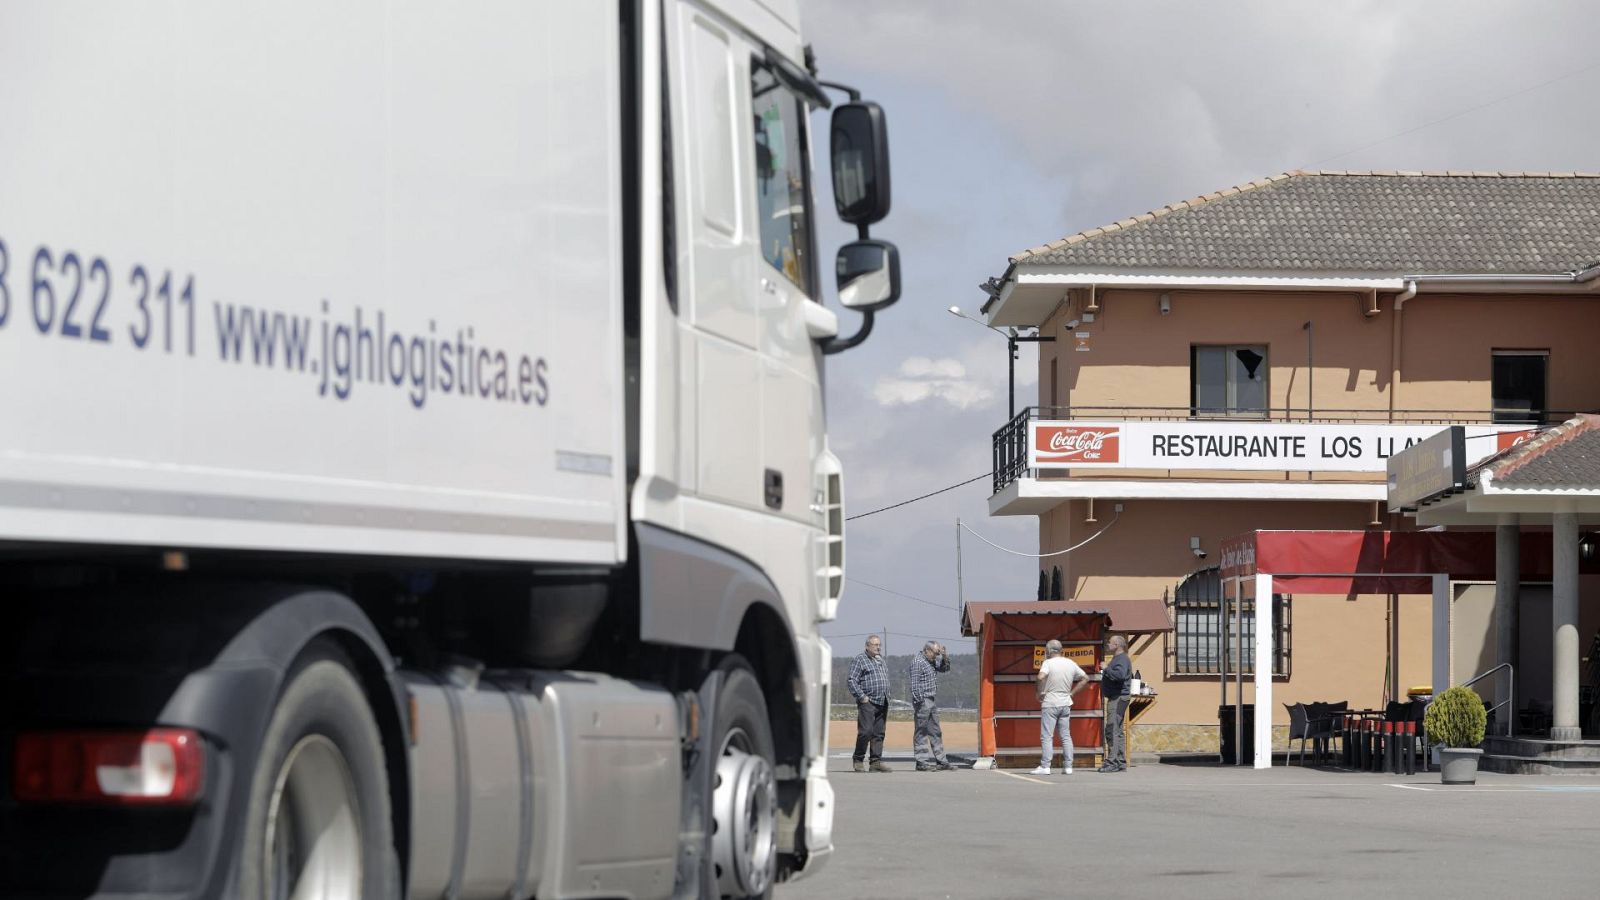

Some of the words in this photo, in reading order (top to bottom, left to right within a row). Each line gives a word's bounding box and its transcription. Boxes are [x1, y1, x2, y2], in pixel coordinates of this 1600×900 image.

[30, 246, 112, 343] 622
[129, 264, 196, 357] 311
[213, 299, 550, 409] www.jghlogistica.es
[1050, 430, 1103, 450] Coca-Cola
[1152, 435, 1306, 458] RESTAURANTE
[1321, 436, 1362, 458] LOS
